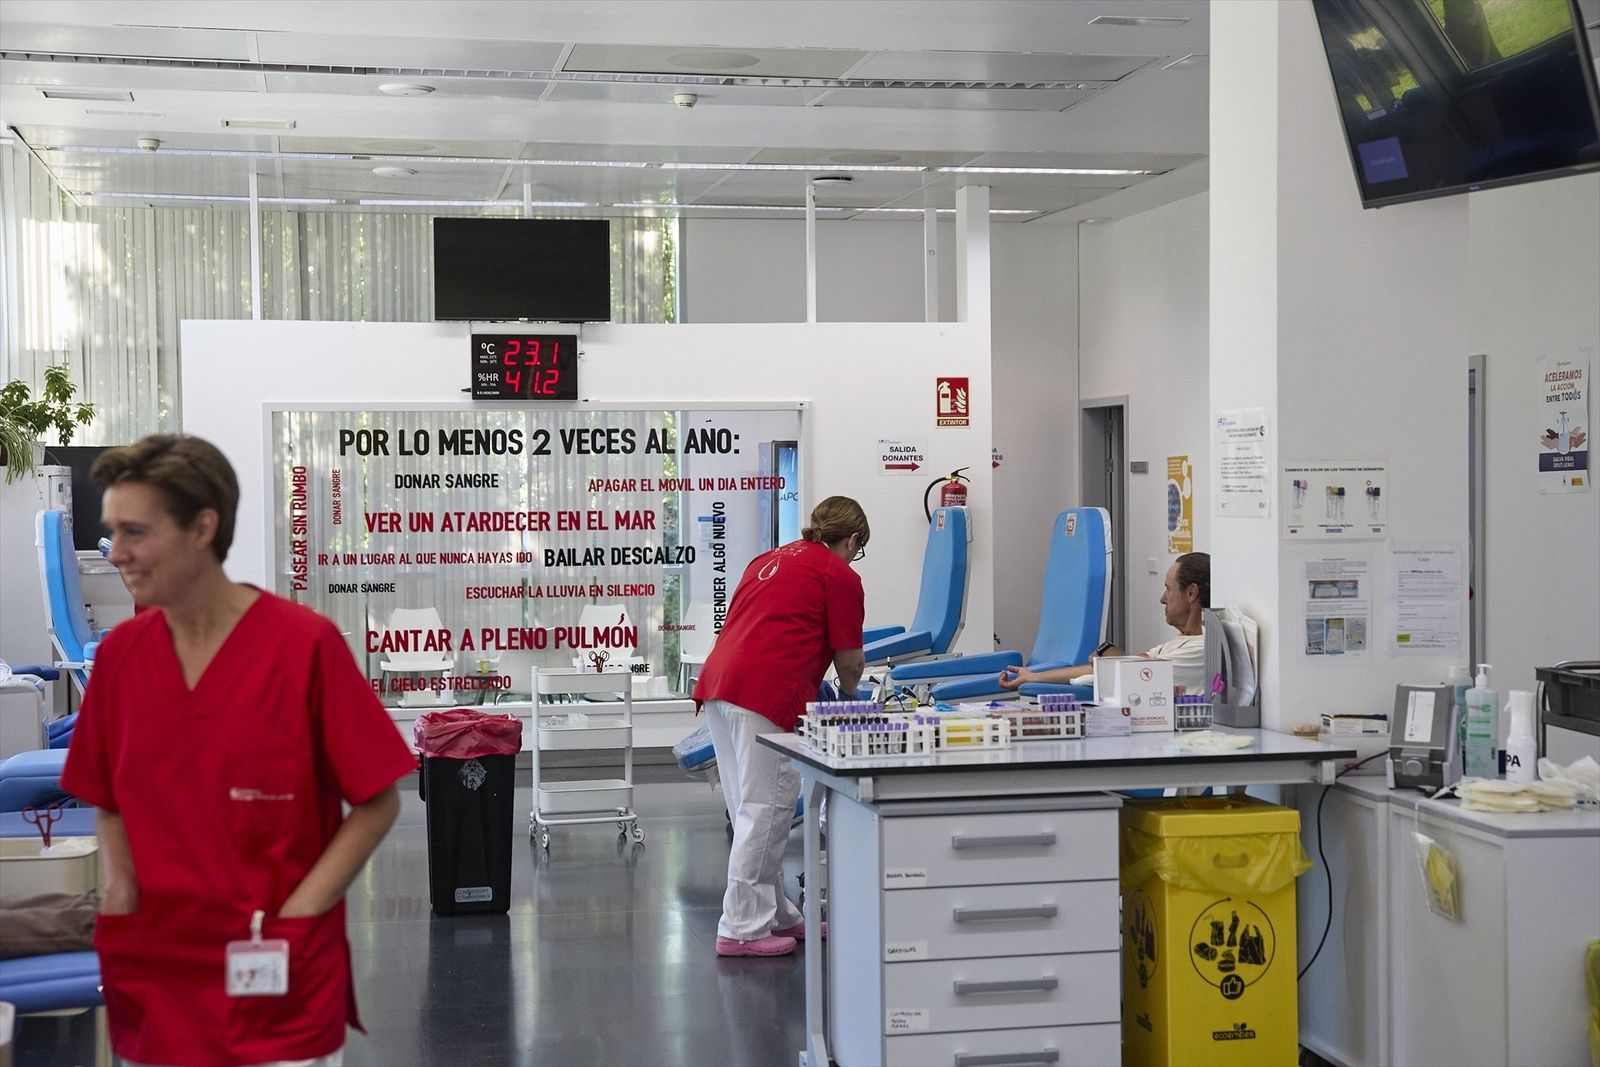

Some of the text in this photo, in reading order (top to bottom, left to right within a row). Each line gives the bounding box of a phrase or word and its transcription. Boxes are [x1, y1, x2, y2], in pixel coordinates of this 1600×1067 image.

[503, 340, 559, 366] 23.1
[477, 372, 499, 382] %HR
[505, 369, 559, 395] 41.2
[1544, 369, 1583, 383] ACELERAMOS
[1546, 394, 1561, 403] ENTRE
[339, 429, 390, 456] POR
[399, 429, 429, 456] LO
[439, 429, 523, 456] MENOS
[532, 428, 552, 456] 2
[559, 428, 636, 455] VECES
[645, 428, 676, 455] AL
[394, 473, 499, 489] DONAR SANGRE
[588, 476, 786, 492] APAGAR EL MOVIL UN DIA ENTERO
[331, 468, 342, 525] DONAR SANGRE
[292, 466, 308, 591] PASEAR SIN RUMBO
[364, 510, 656, 533] VER UN ATARDECER EN EL MAR
[713, 501, 725, 539] NUEVO
[318, 552, 533, 566] IR A UN LUGAR AL QUE NUNCA HAYAS IDO
[544, 546, 696, 567] BAILAR DESCALZO
[713, 543, 726, 572] ALGO
[328, 582, 396, 593] DONAR SANGRE
[466, 584, 655, 599] ESCUCHAR LA LLUVIA EN SILENCIO
[366, 614, 638, 653] CANTAR A PLENO PULMÓN
[372, 675, 511, 692] EL CIELO ESTRELLADO
